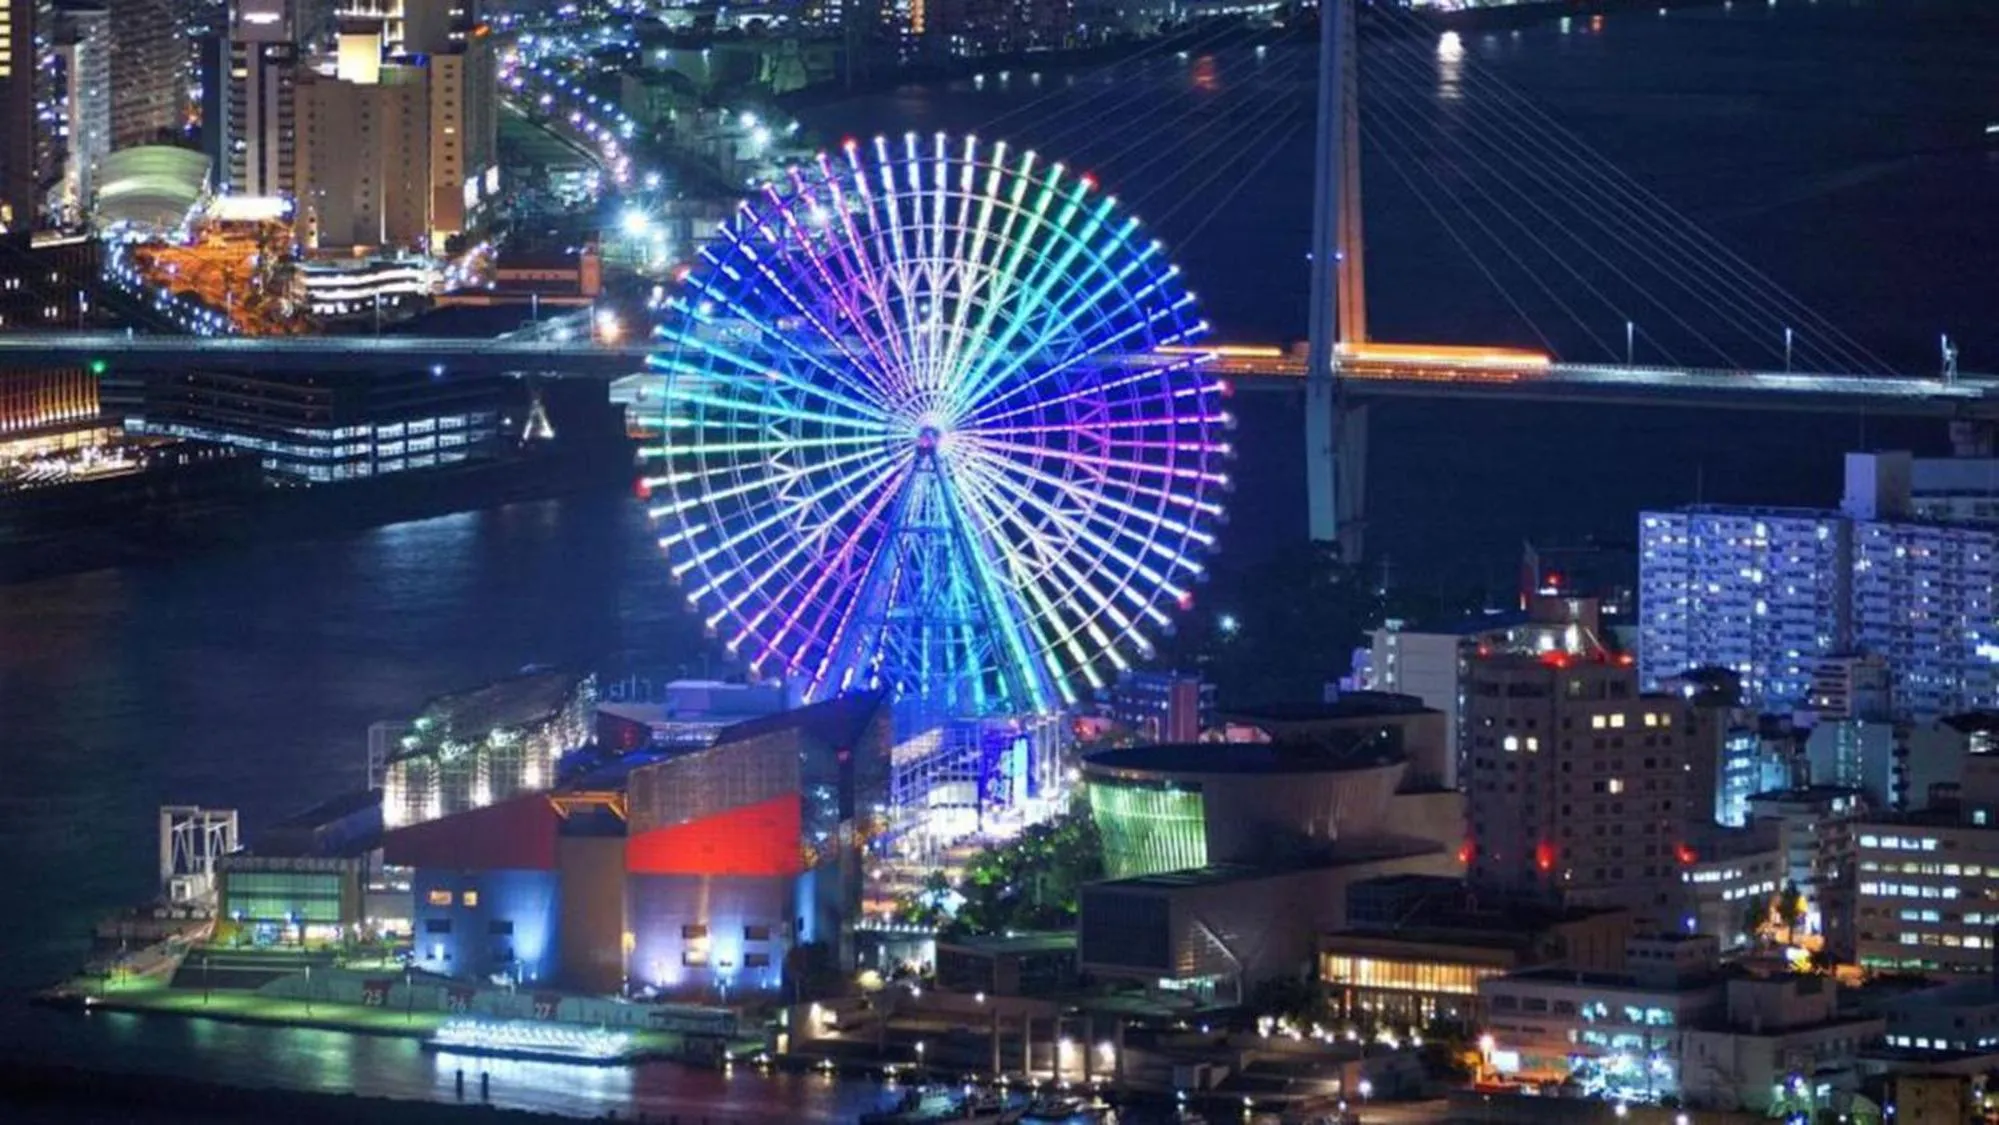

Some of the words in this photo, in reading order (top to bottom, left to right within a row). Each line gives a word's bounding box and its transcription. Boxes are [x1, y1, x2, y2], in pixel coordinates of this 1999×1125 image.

[223, 857, 264, 870] PORT
[270, 857, 289, 870] OF
[295, 857, 348, 871] OSAKA
